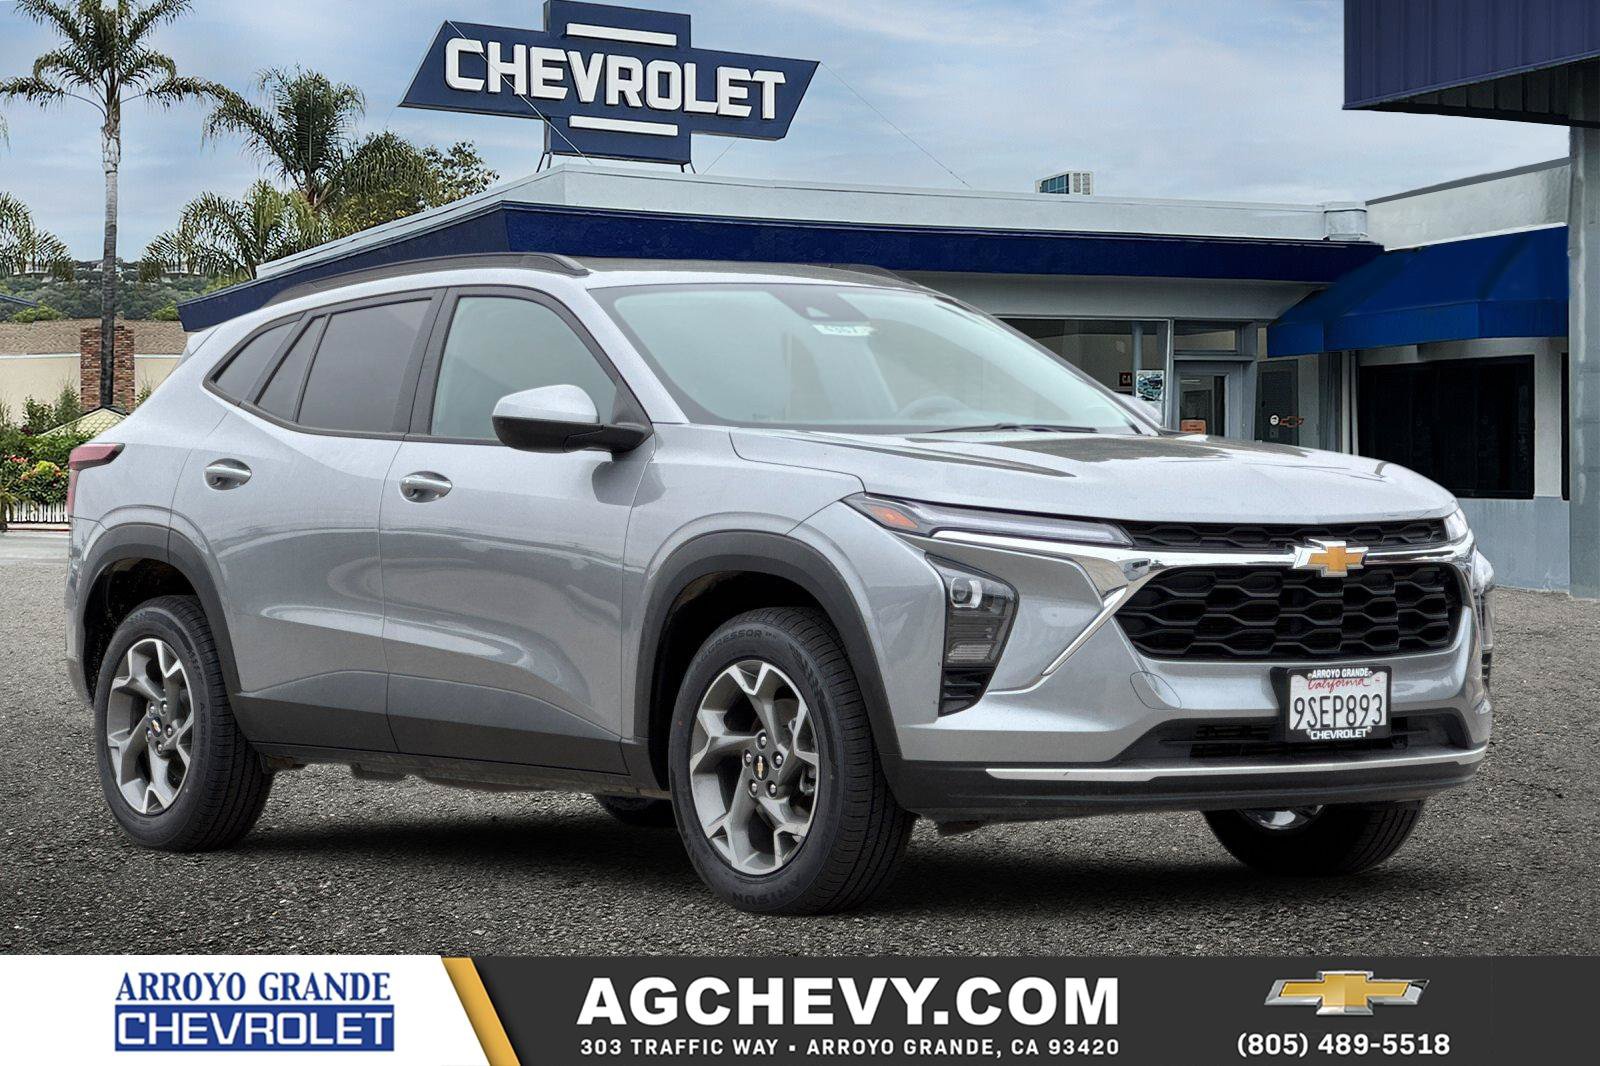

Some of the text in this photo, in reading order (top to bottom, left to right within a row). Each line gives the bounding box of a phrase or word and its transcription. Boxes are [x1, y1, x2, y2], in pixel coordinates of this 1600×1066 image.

[445, 37, 786, 120] CHEVROLET
[1312, 668, 1369, 679] ARROYO GRANDE
[1308, 678, 1370, 693] California
[1294, 694, 1383, 730] 9SEP893
[1310, 727, 1367, 740] CHEVROLET
